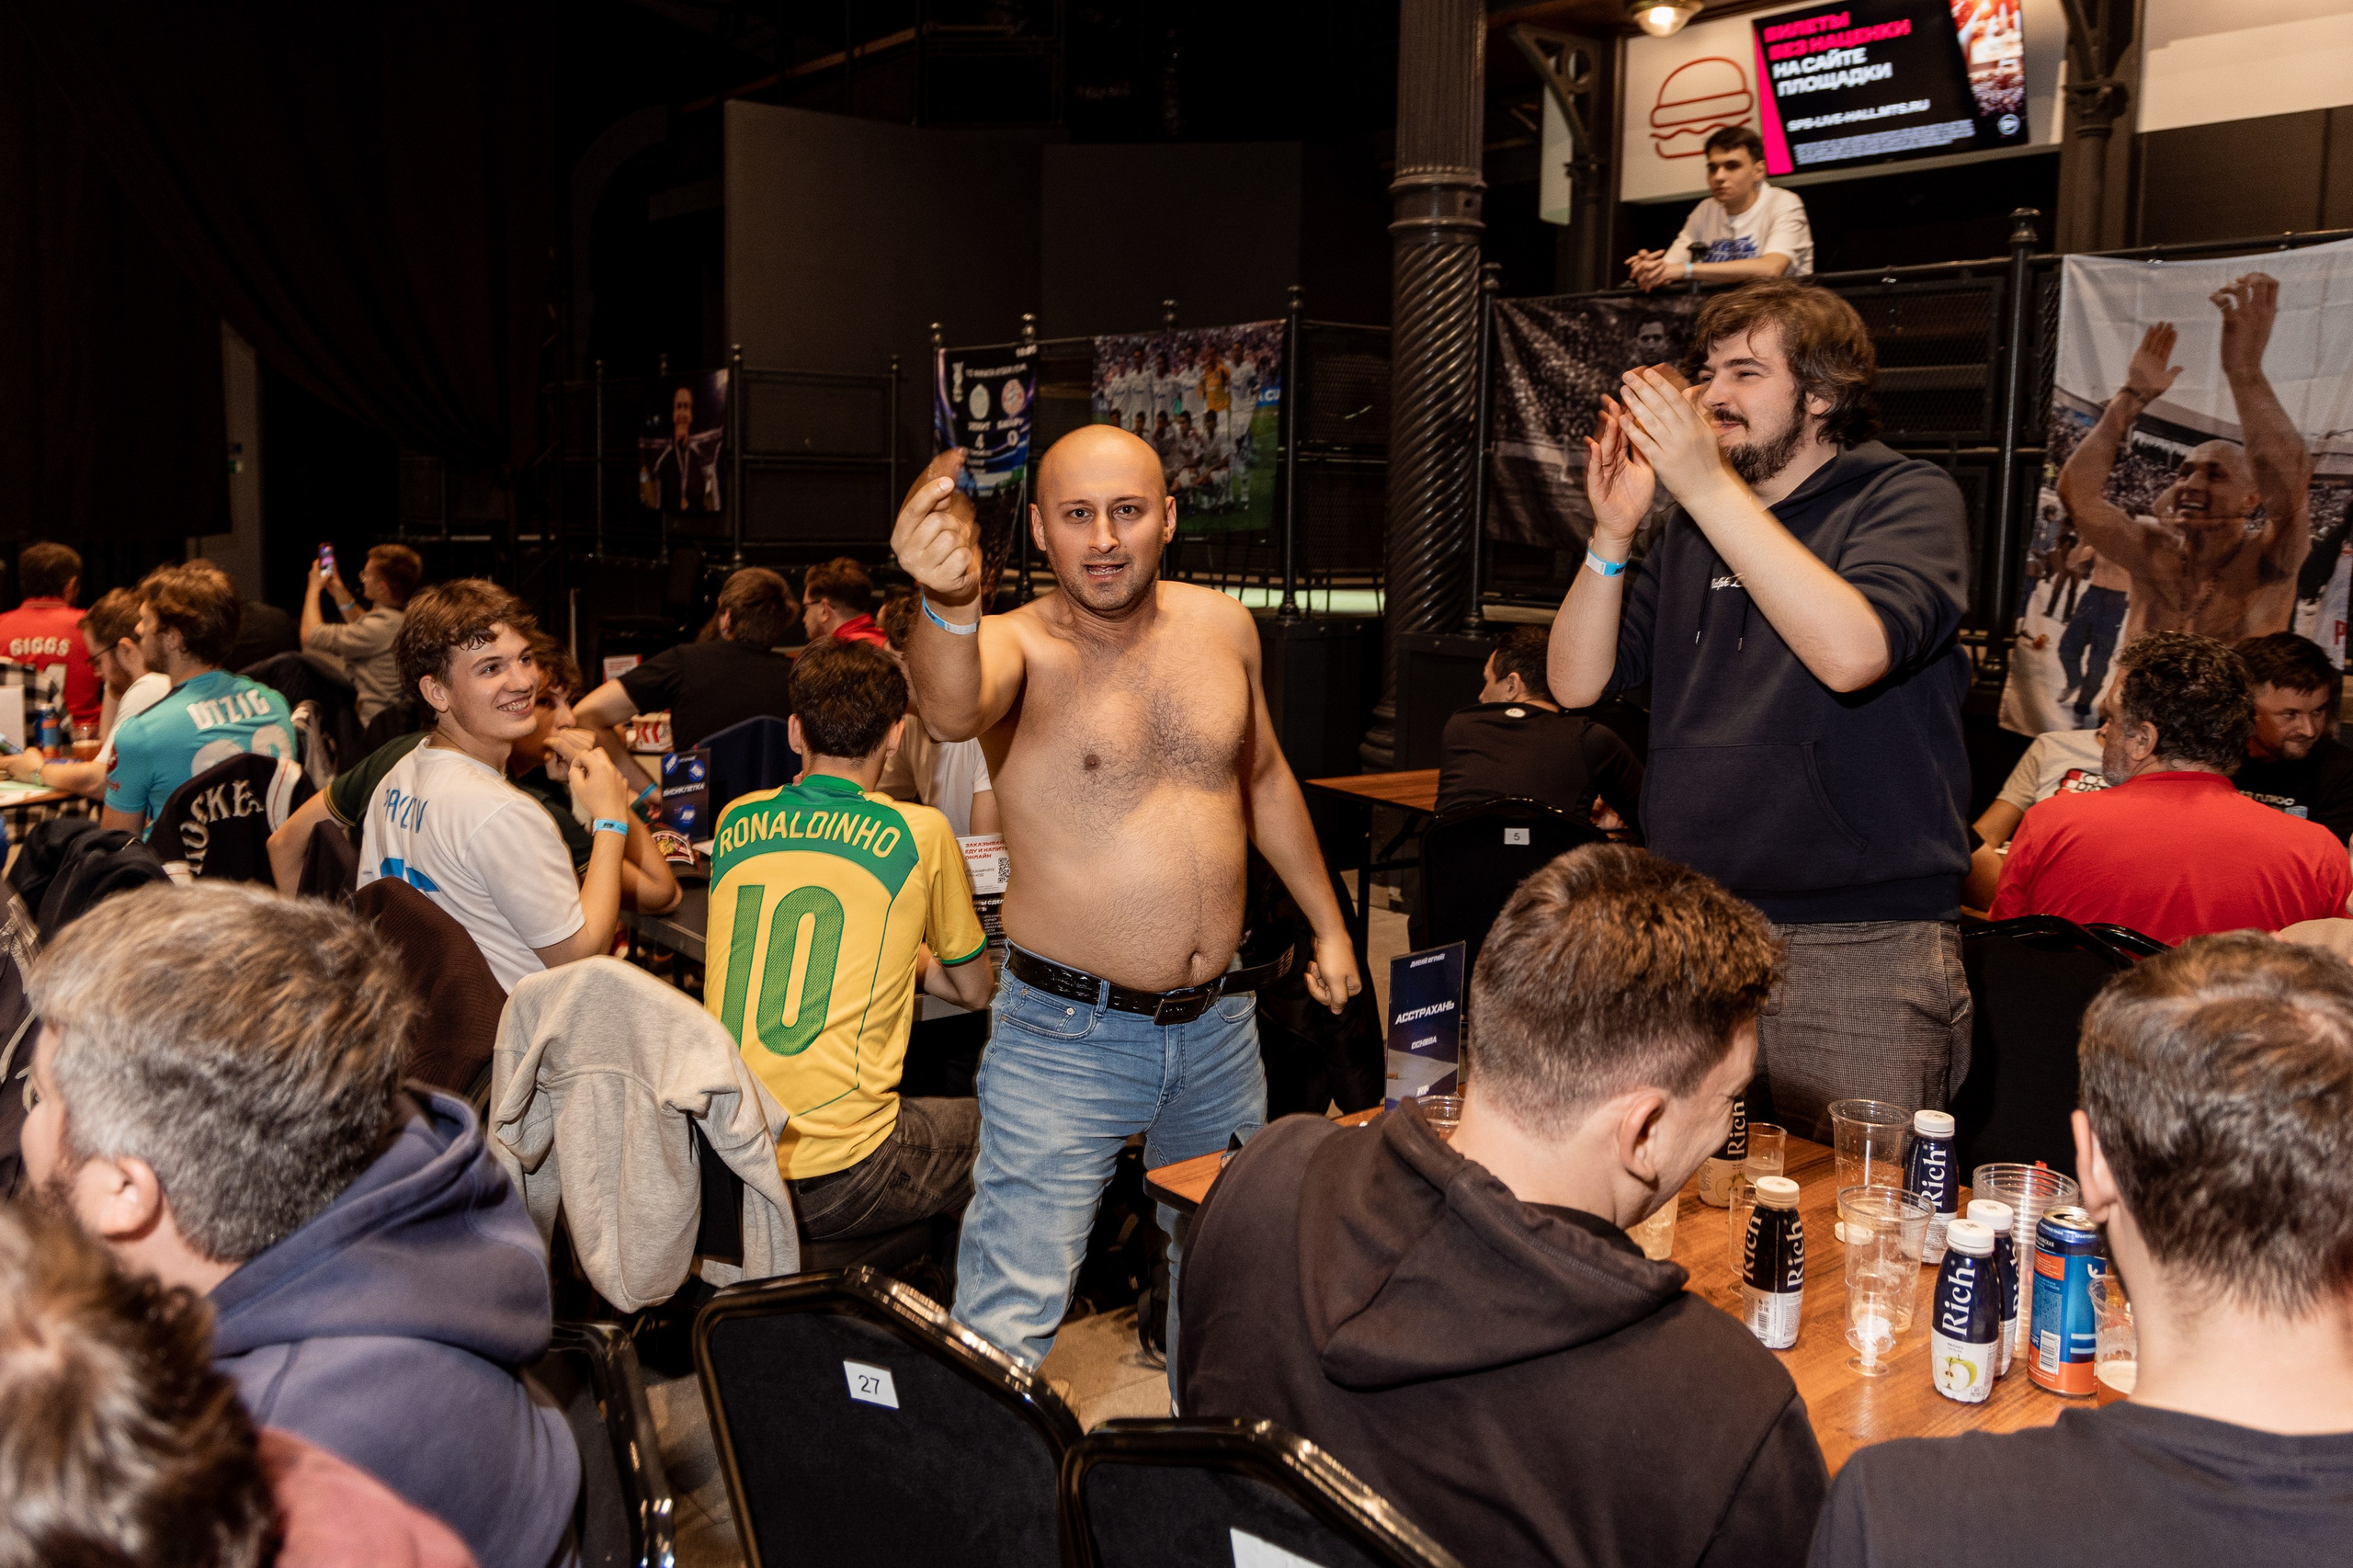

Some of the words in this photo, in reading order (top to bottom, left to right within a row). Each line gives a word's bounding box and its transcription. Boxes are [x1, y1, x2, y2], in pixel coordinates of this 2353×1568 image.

[1764, 11, 1850, 42] БИЛЕТЫ
[1768, 40, 1808, 61] БЕЗ
[1809, 18, 1912, 52] НАЦЕНКИ
[1772, 60, 1801, 79] НА
[1801, 47, 1867, 74] САЙТЕ
[1777, 62, 1893, 97] ПЛОЩАДКИ
[9, 635, 71, 657] GIGGS
[718, 810, 902, 858] RONALDINHO
[965, 839, 1005, 848] ЗАКАЗЫВАЙ
[1513, 832, 1520, 841] 5
[719, 884, 845, 1057] 10
[1394, 999, 1455, 1025] АССТРАХАНЬ
[1727, 1100, 1745, 1155] Rich
[1921, 1149, 1947, 1209] Rich
[1743, 1215, 1762, 1280] Rich
[1786, 1220, 1805, 1289] Rich
[1942, 1267, 1976, 1337] Rich
[856, 1373, 881, 1397] 27
